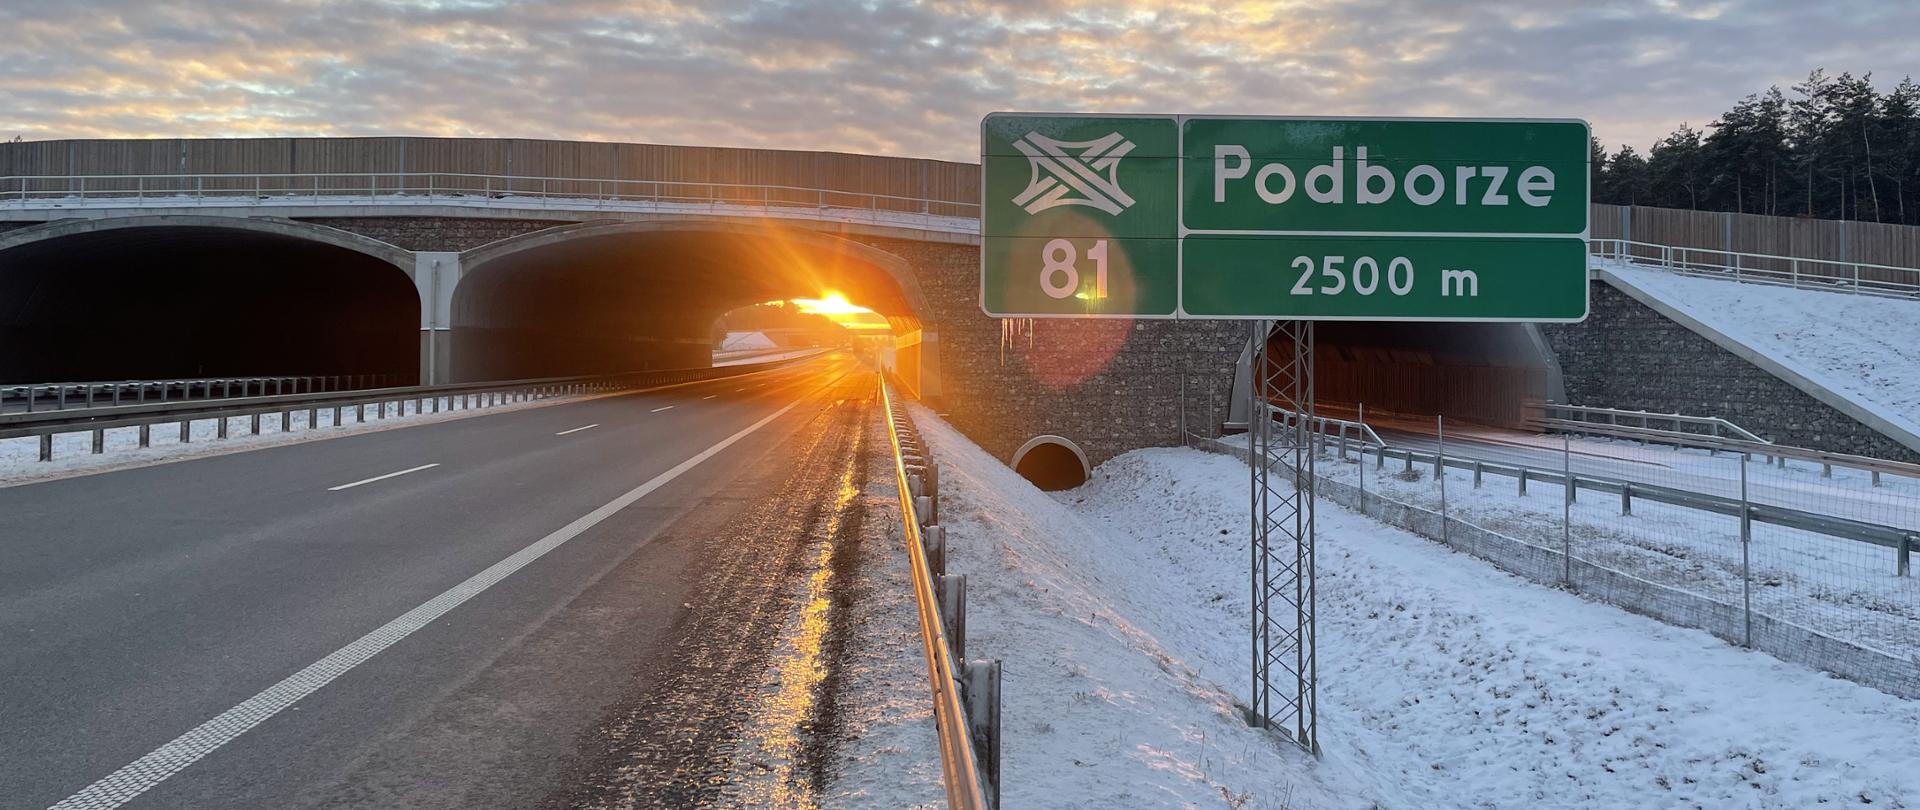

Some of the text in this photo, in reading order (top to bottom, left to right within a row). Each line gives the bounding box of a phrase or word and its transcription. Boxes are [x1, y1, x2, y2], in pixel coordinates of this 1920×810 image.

[1212, 144, 1557, 207] Podborze
[1040, 238, 1109, 299] 81
[1290, 255, 1479, 297] 2500 m
